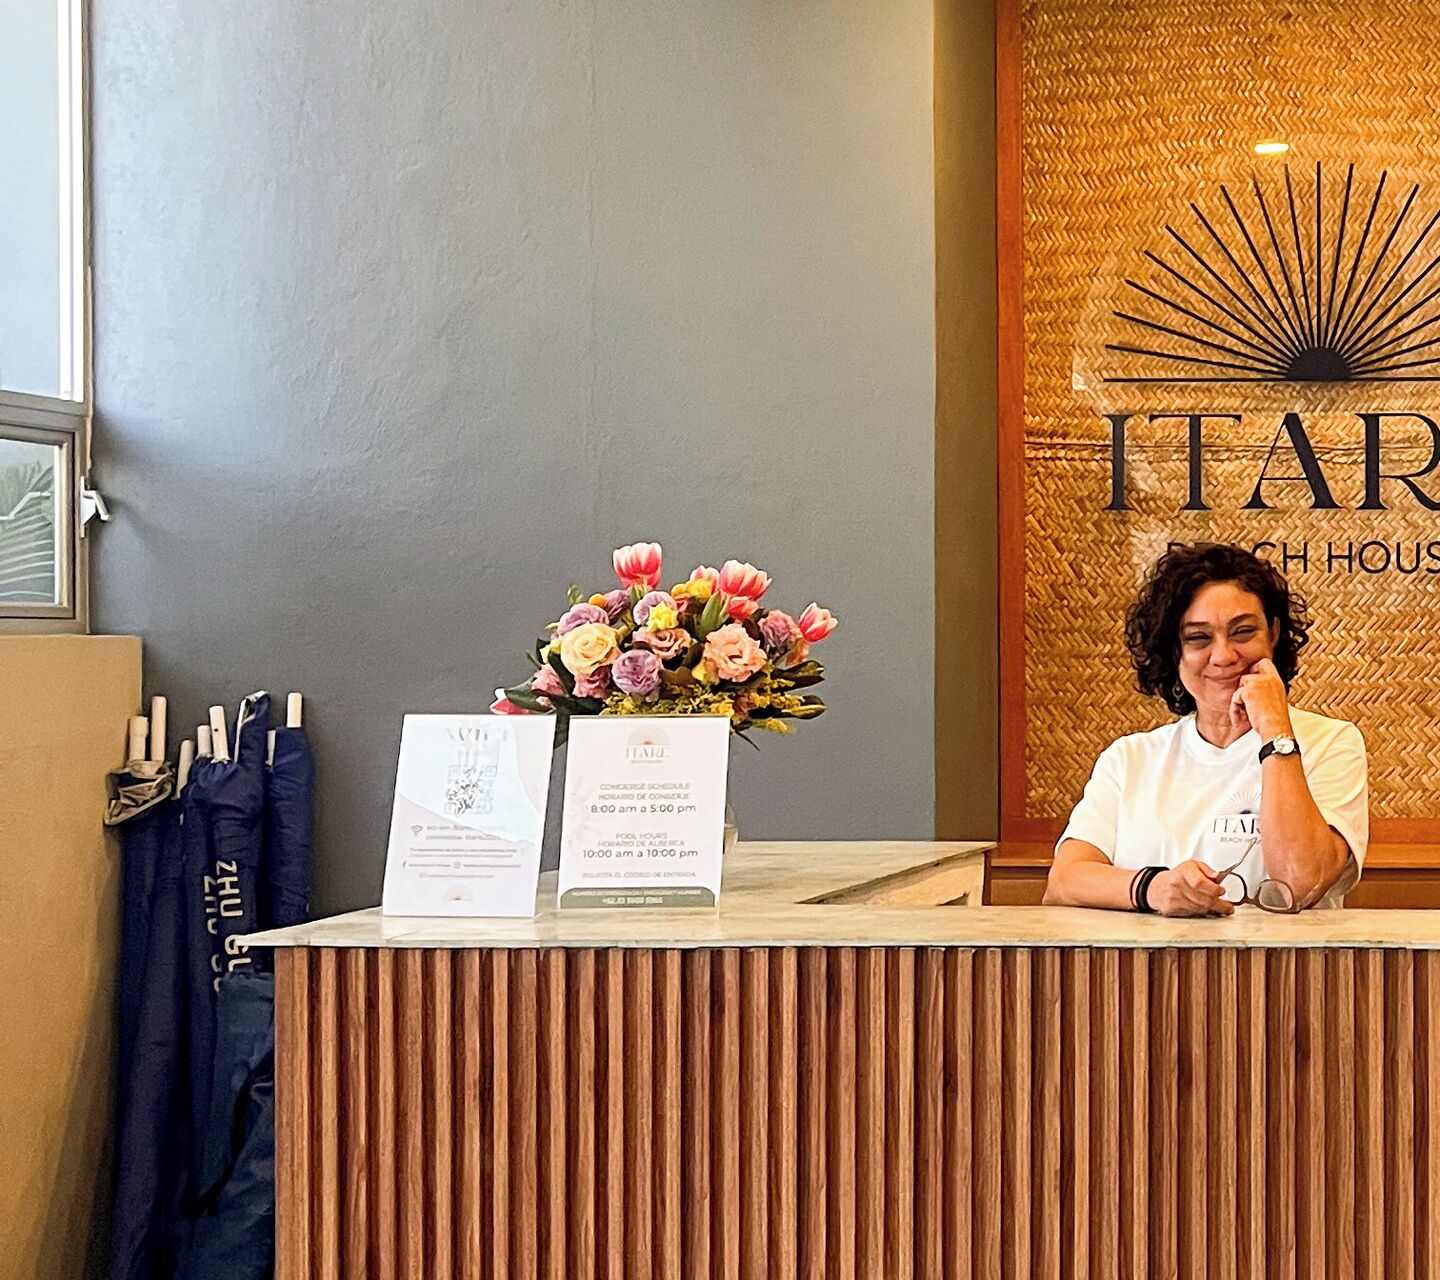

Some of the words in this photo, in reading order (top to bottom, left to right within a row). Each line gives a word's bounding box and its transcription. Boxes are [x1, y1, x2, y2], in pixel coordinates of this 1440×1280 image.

[591, 804, 616, 813] 8:00
[650, 804, 674, 813] 5:00
[677, 805, 696, 814] pm
[1212, 818, 1262, 834] ITAR
[583, 849, 612, 858] 10:00
[647, 849, 676, 858] 10:00
[679, 850, 698, 858] pm
[216, 860, 244, 917] ZHU
